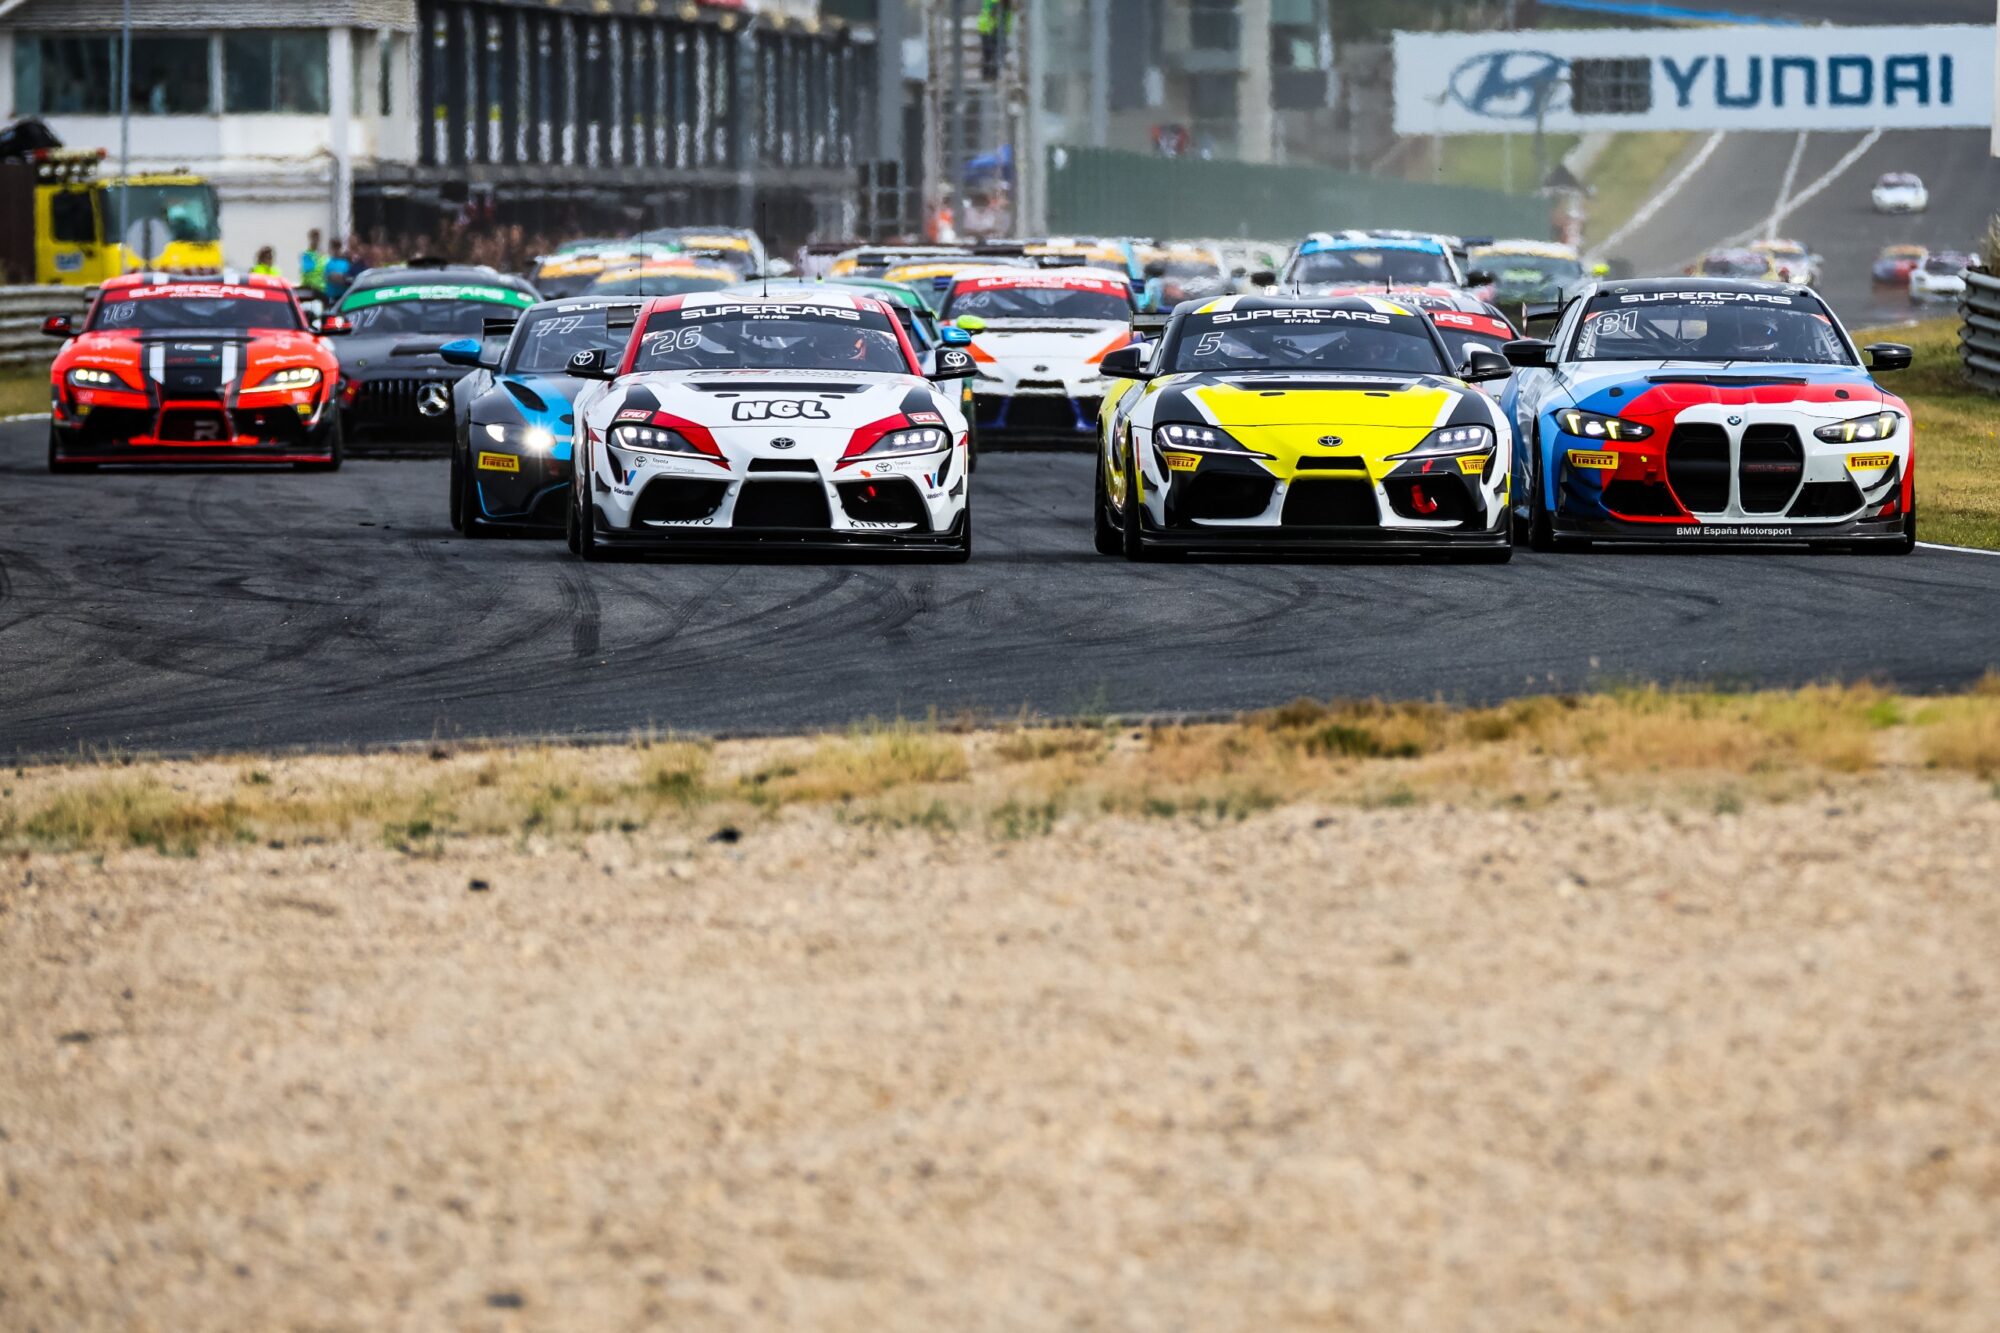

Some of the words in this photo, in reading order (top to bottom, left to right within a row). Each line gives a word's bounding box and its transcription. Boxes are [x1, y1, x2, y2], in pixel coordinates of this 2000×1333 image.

[1659, 54, 1953, 108] YUNDAI
[978, 276, 1103, 289] SUPERCARS
[129, 284, 266, 298] SUPERCARS
[375, 285, 505, 300] SUPERCARS
[1620, 291, 1792, 305] SUPERCARS
[681, 304, 860, 321] SUPERCARS
[1212, 308, 1391, 324] SUPERCARS
[536, 315, 584, 337] 77
[1595, 310, 1638, 336] 81
[651, 325, 702, 356] 26
[1194, 331, 1224, 356] 5
[732, 399, 831, 421] NGL
[483, 455, 515, 468] PIRELLI
[1572, 453, 1613, 466] PIRELLI
[1851, 455, 1890, 467] PIRELLI
[1676, 526, 1701, 536] BMW
[1703, 526, 1738, 537] España
[1740, 526, 1792, 537] Motorsport
